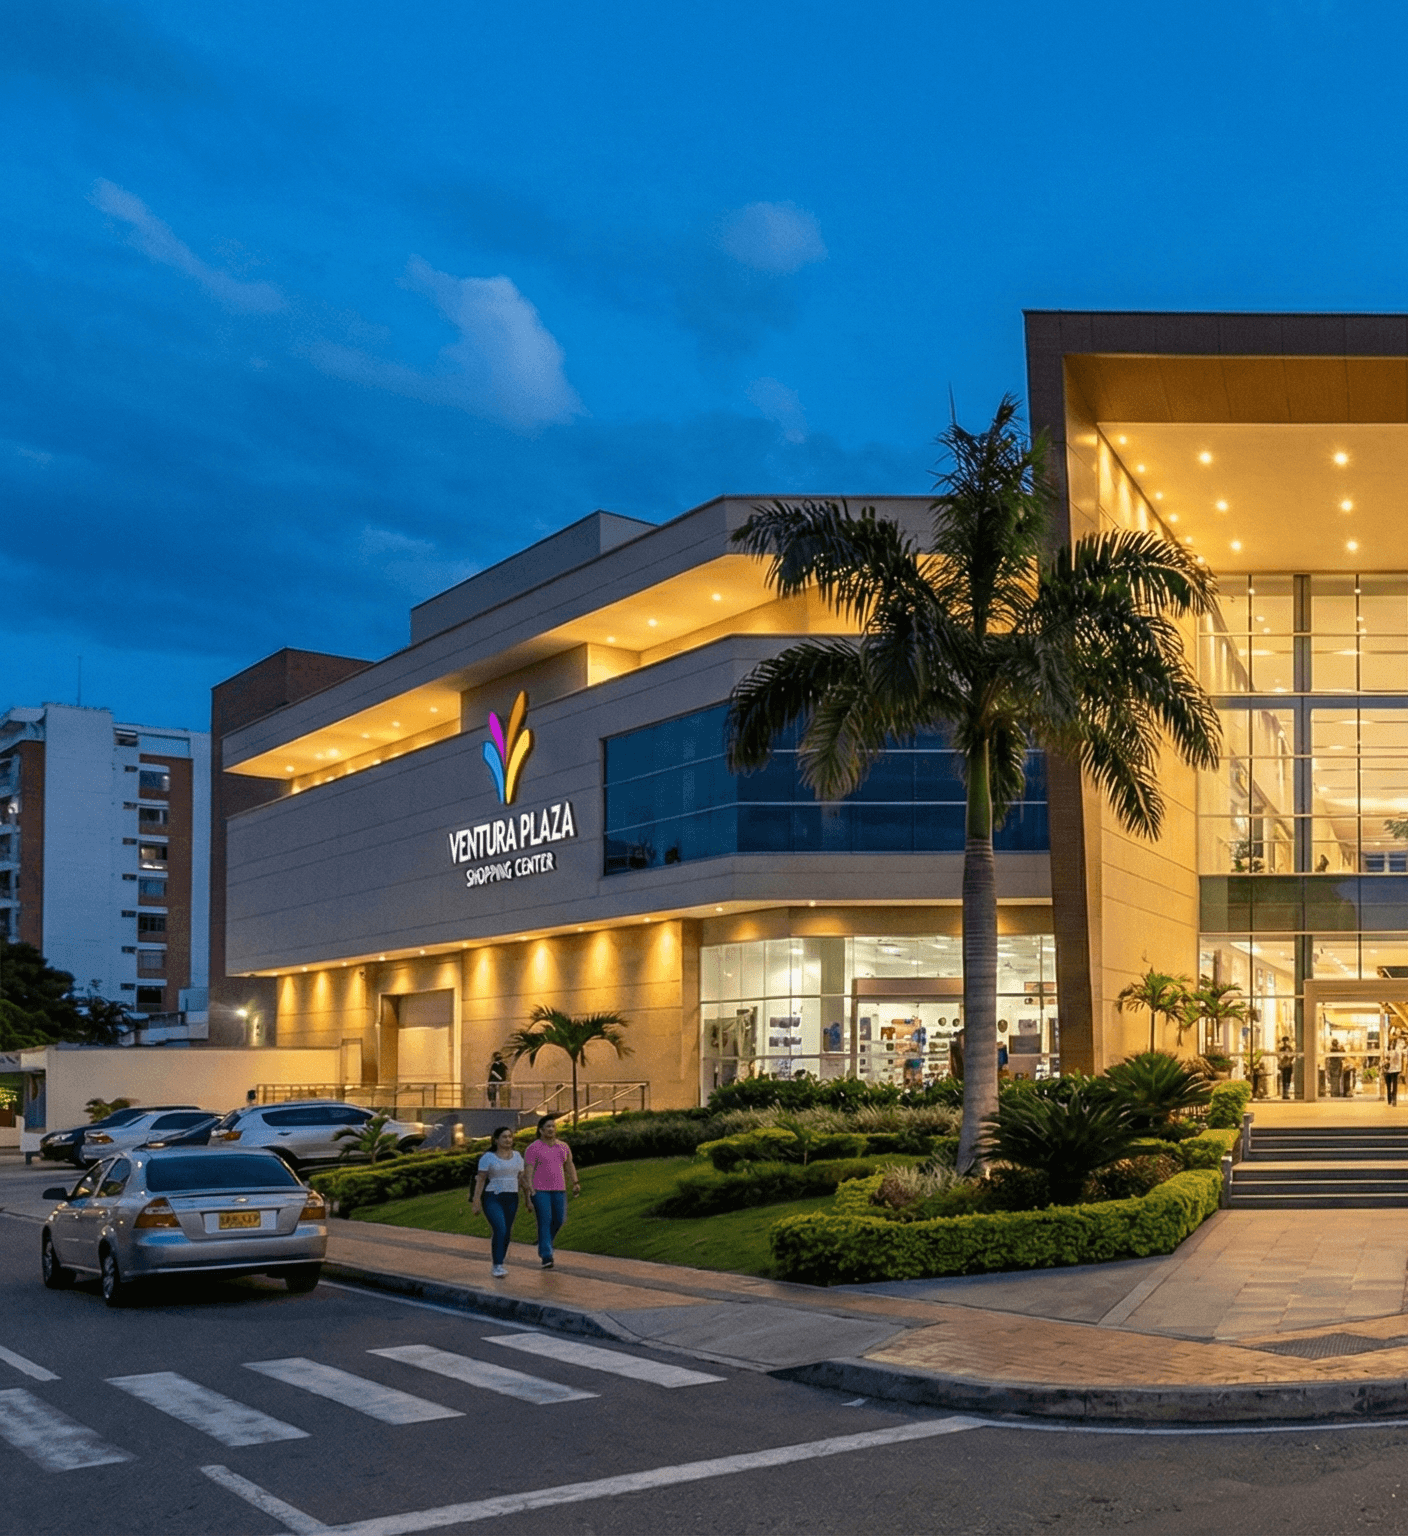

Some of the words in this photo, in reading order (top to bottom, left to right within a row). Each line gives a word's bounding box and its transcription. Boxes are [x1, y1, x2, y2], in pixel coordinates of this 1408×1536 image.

[449, 817, 517, 864] VENTURA
[520, 801, 575, 848] PLAZA
[466, 860, 512, 887] SHOPPING
[514, 852, 554, 877] CENTER
